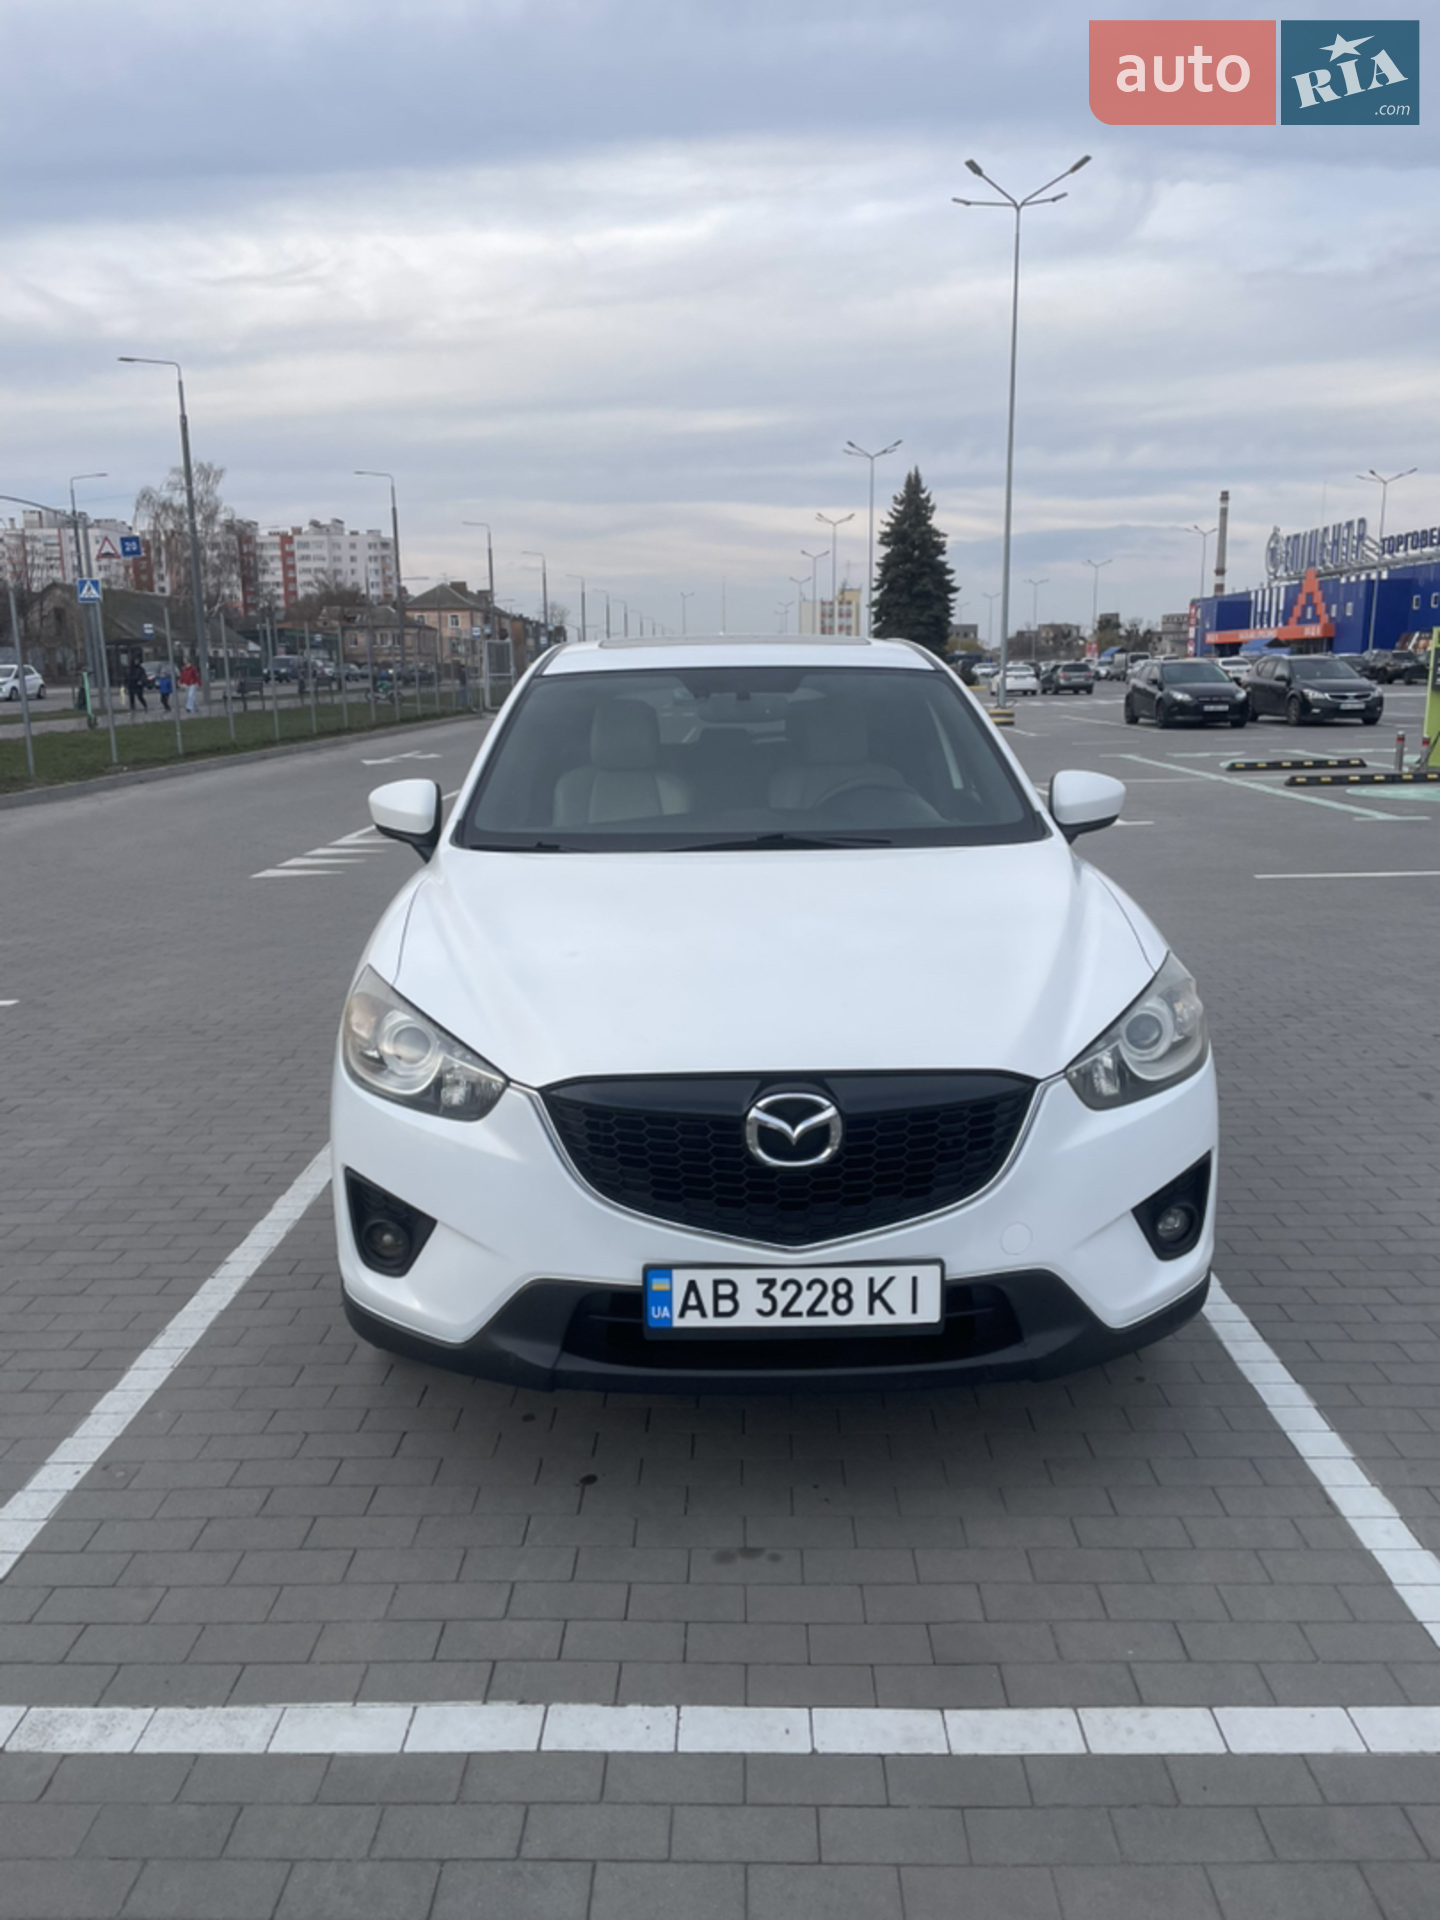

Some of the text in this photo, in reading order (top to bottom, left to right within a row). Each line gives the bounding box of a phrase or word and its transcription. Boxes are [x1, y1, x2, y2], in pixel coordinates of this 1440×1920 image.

[1380, 526, 1440, 555] ТОРГОВЕ
[677, 1275, 919, 1319] AB 3228 KI
[651, 1306, 672, 1319] UA
